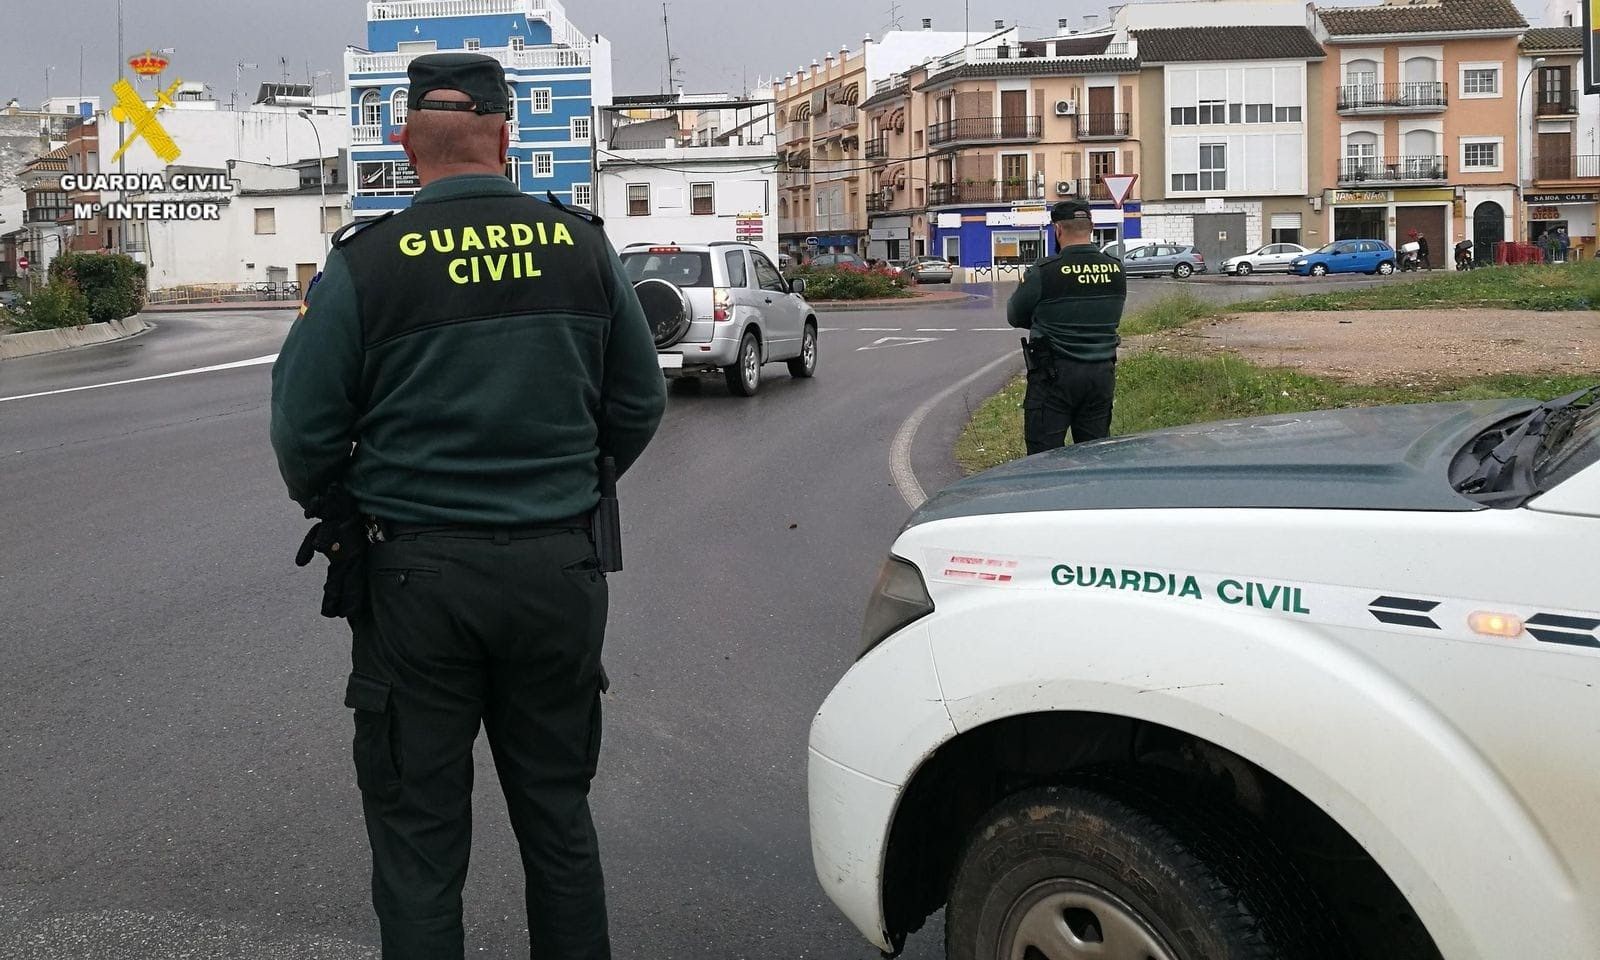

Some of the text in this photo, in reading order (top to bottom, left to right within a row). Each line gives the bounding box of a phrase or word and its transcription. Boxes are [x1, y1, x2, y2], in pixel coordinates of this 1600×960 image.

[399, 221, 574, 257] GUARDIA
[448, 252, 542, 284] CIVIL
[1061, 264, 1120, 274] GUARDIA
[1077, 274, 1112, 284] CIVIL
[1050, 564, 1311, 615] GUARDIA CIVIL
